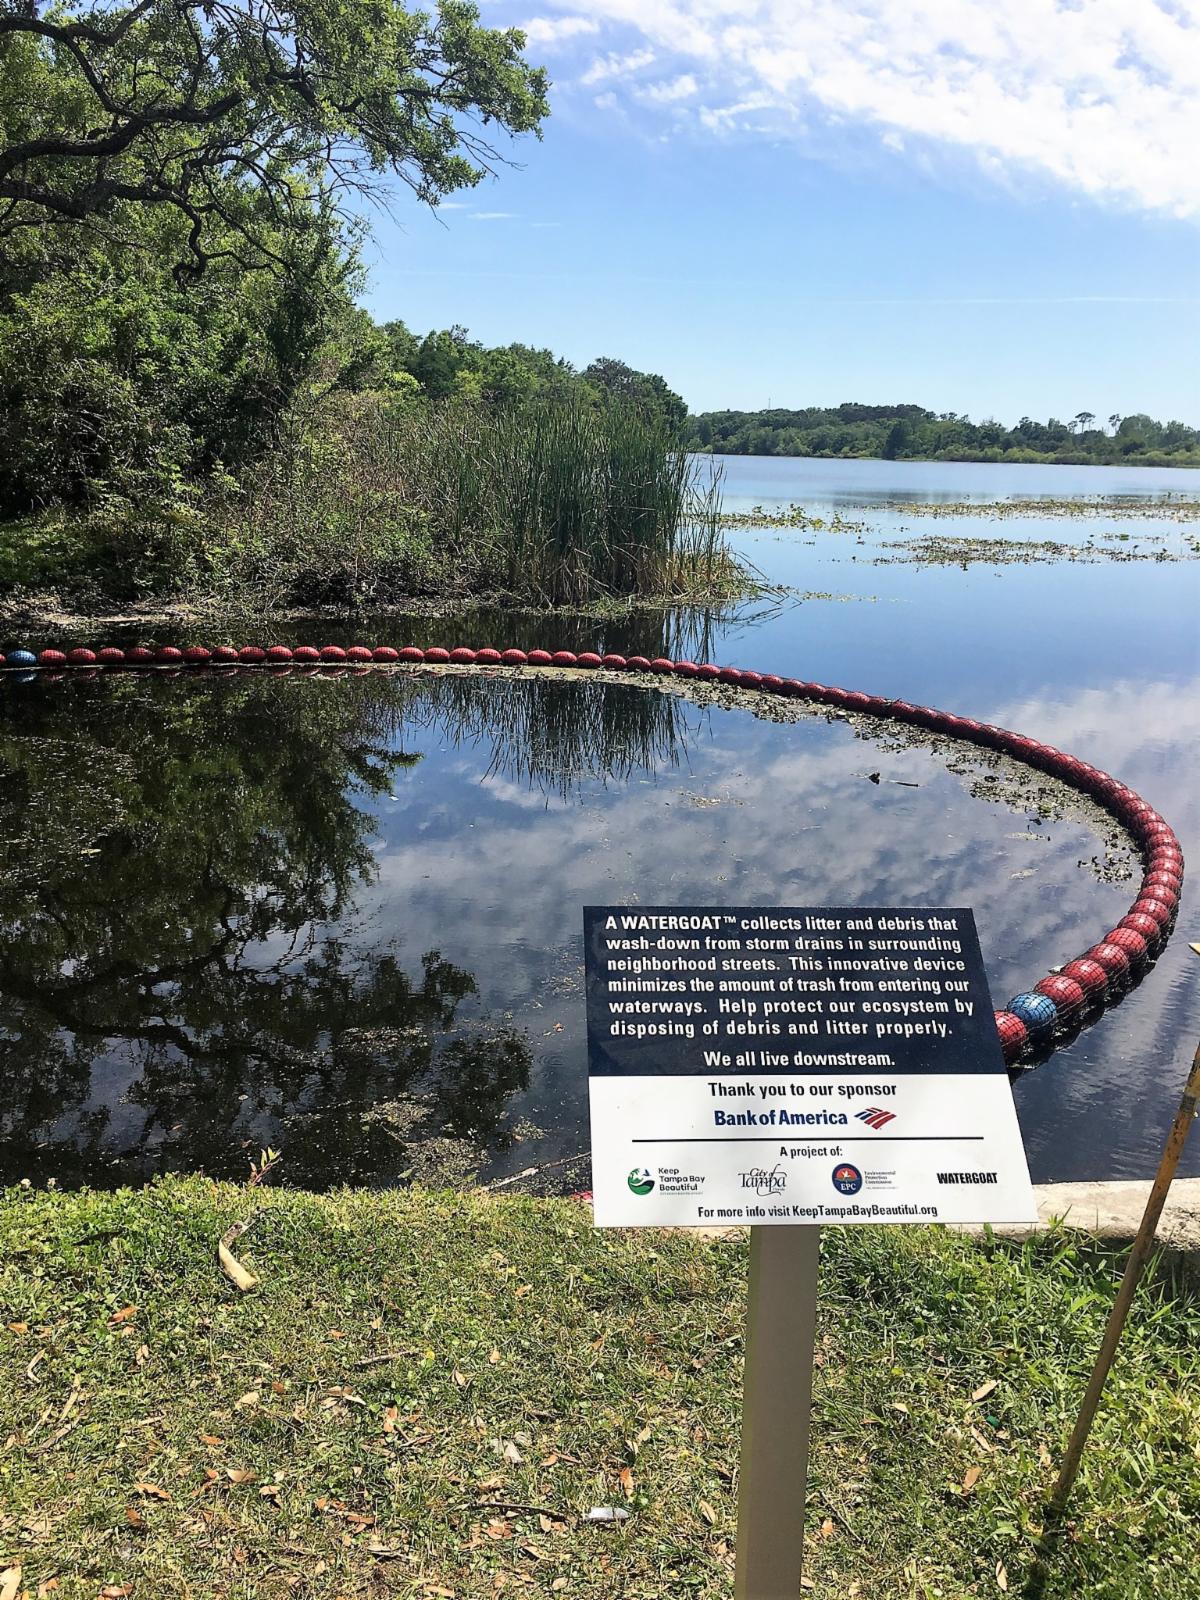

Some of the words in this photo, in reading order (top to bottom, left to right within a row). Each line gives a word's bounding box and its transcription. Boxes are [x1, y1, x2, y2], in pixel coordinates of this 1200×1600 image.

[605, 916, 617, 930] A
[741, 916, 801, 930] collects
[806, 916, 841, 930] litter
[846, 917, 873, 930] and
[878, 917, 924, 930] debris
[928, 917, 958, 931] that
[606, 936, 700, 950] wash-down
[705, 936, 741, 950] from
[746, 938, 790, 950] storm
[795, 937, 843, 950] drains
[848, 937, 863, 950] in
[868, 937, 962, 953] surrounding
[607, 957, 716, 973] neighborhood
[722, 958, 781, 971] streets.
[789, 957, 823, 971] This
[828, 957, 909, 971] innovative
[914, 957, 965, 971] device
[608, 978, 686, 992] minimizes
[690, 978, 714, 992] the
[719, 979, 776, 992] amount
[779, 977, 794, 992] of
[797, 977, 836, 992] trash
[839, 977, 874, 992] from
[878, 978, 941, 995] entering
[944, 981, 969, 992] our
[608, 1001, 707, 1016] waterways.
[719, 998, 757, 1016] Help
[764, 1000, 823, 1016] protect
[829, 1001, 856, 1013] our
[862, 1000, 949, 1016] ecosystem
[955, 998, 974, 1016] by
[610, 1020, 695, 1039] disposing
[702, 1020, 719, 1035] of
[727, 1020, 781, 1035] debris
[788, 1020, 818, 1035] and
[826, 1020, 868, 1035] litter
[876, 1020, 953, 1038] properly.
[704, 1051, 732, 1066] We
[736, 1051, 756, 1066] all
[761, 1051, 789, 1066] live
[794, 1051, 895, 1066] downstream.
[708, 1082, 756, 1096] Thank
[759, 1085, 786, 1099] you
[790, 1084, 805, 1096] to
[809, 1085, 833, 1096] our
[838, 1085, 896, 1099] sponsor
[714, 1110, 758, 1126] Bank
[759, 1109, 776, 1125] of
[779, 1109, 848, 1125] America
[780, 1146, 788, 1157] A
[790, 1146, 827, 1159] project
[830, 1146, 843, 1157] of:
[658, 1167, 679, 1175] Keep
[936, 1172, 998, 1184] WATERGOAT
[659, 1175, 688, 1183] Tampa
[689, 1175, 705, 1183] Bay
[659, 1183, 698, 1191] Beautiful
[840, 1183, 856, 1191] EPC
[698, 1206, 715, 1217] For
[717, 1208, 743, 1217] more
[745, 1205, 766, 1217] info
[768, 1205, 790, 1217] visit
[792, 1204, 938, 1218] KeepTampaBayBeautiful.org
